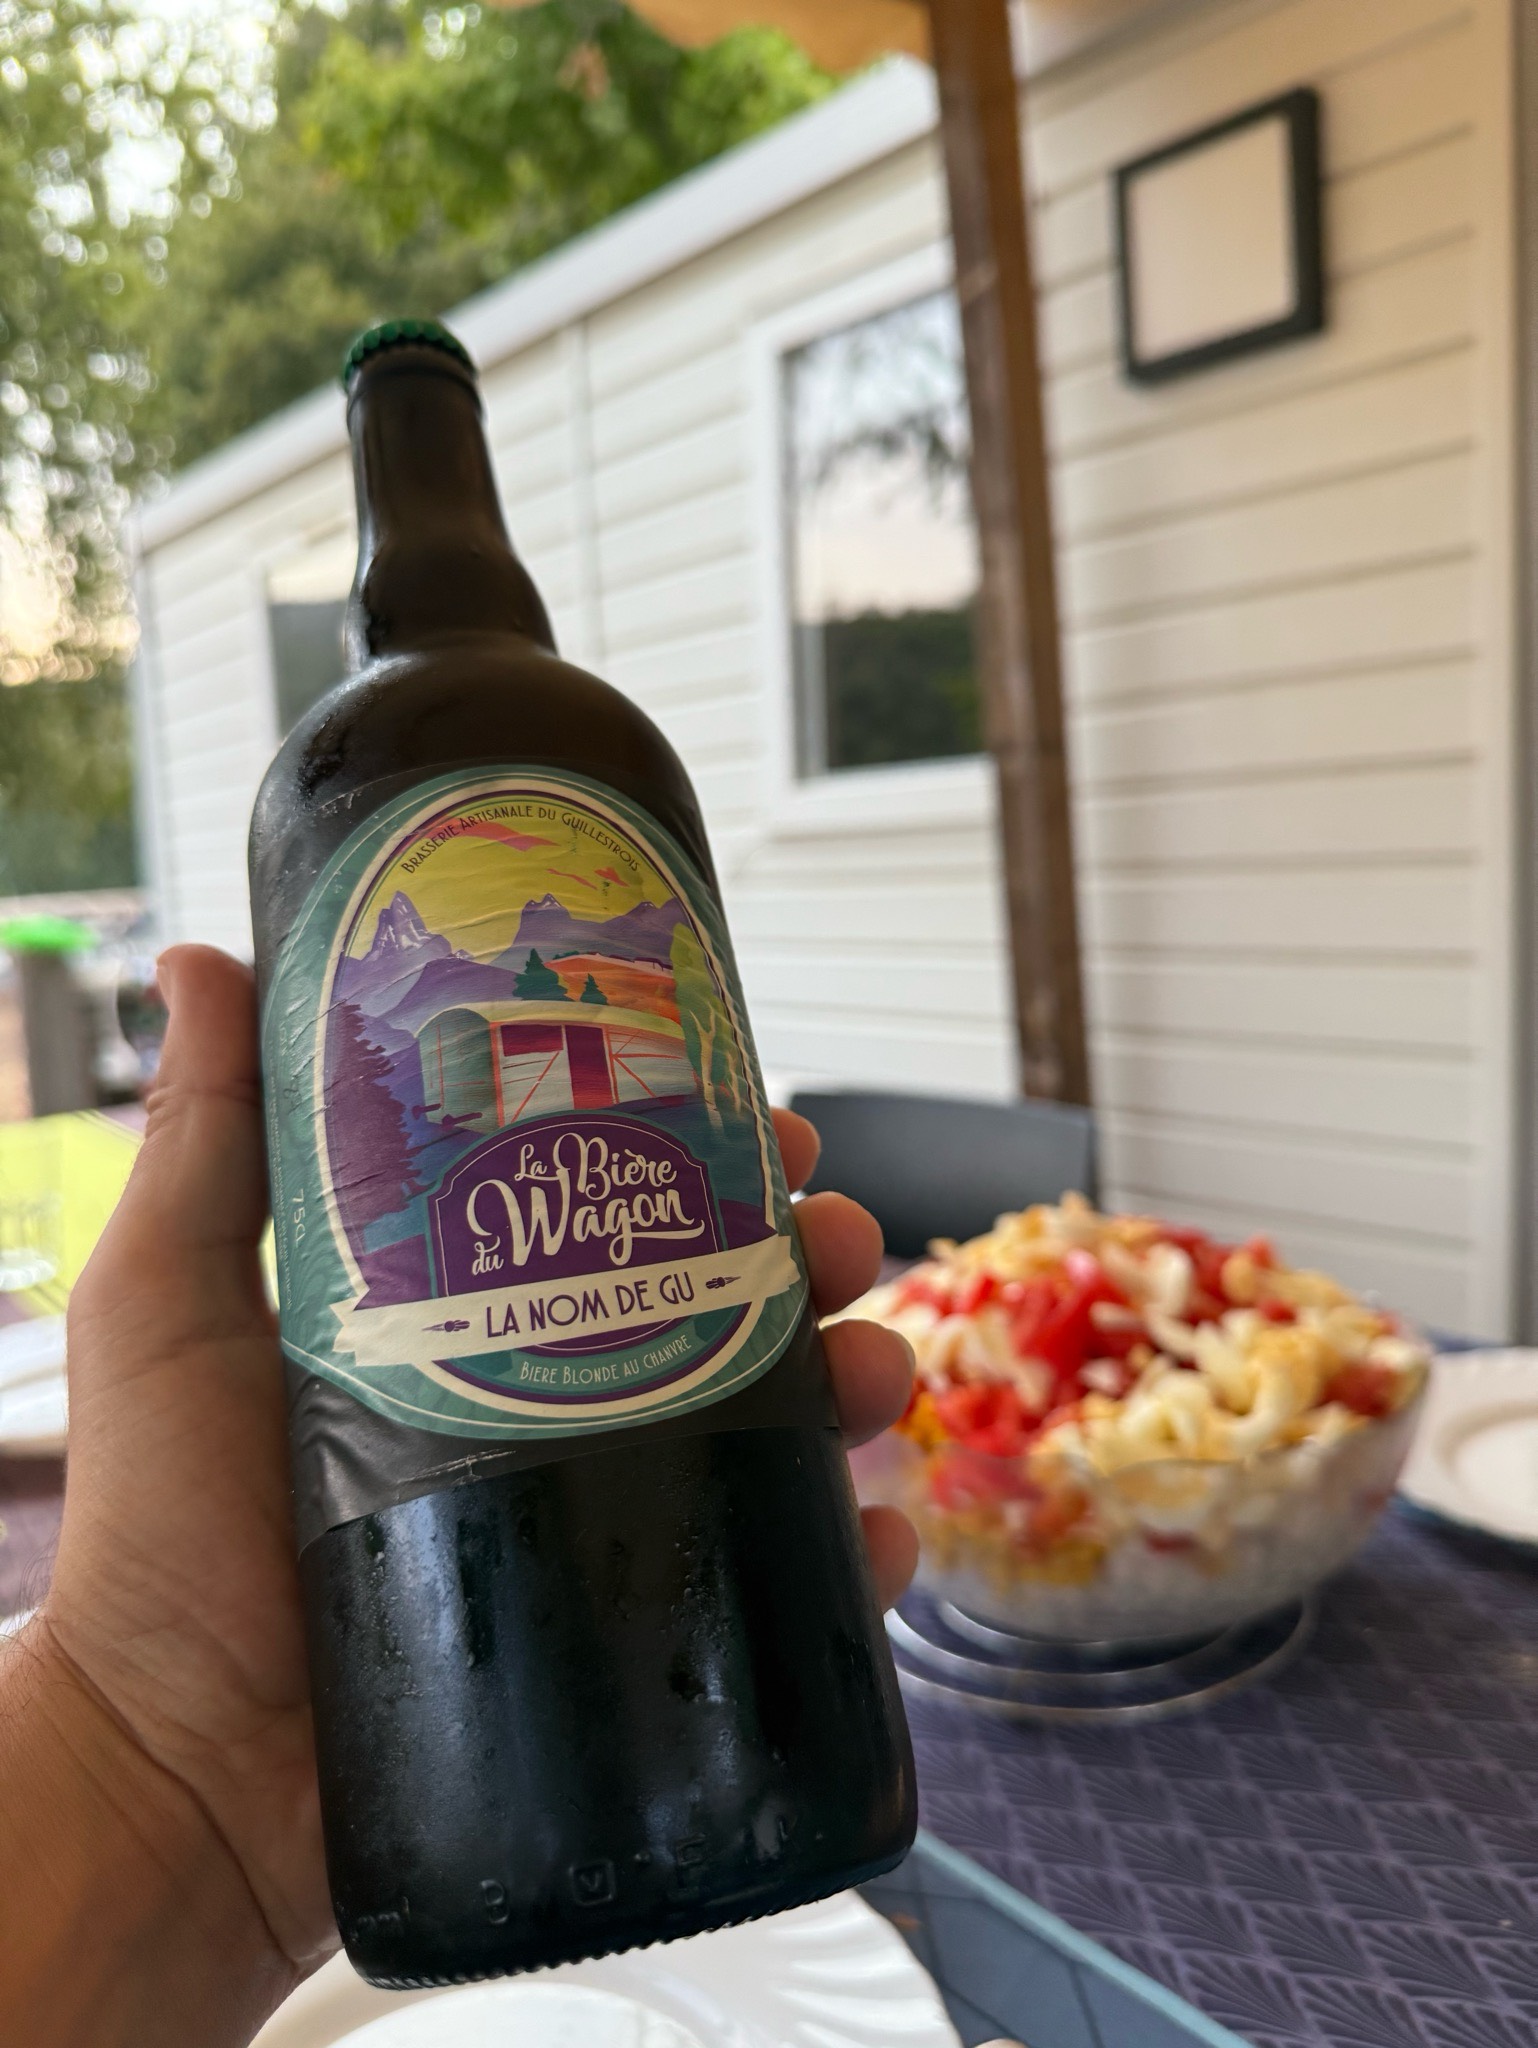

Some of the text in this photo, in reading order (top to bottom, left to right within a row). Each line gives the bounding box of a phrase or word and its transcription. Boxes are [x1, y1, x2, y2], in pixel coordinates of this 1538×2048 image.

[401, 805, 642, 874] BRASSERIE ARTISANALE DU GUILLESTROIS
[514, 1132, 678, 1200] La Bière
[466, 1168, 706, 1276] du Wagon
[486, 1271, 695, 1338] LA NOM DE GU
[519, 1333, 693, 1385] BIERE BLONDE AU CHANVRE
